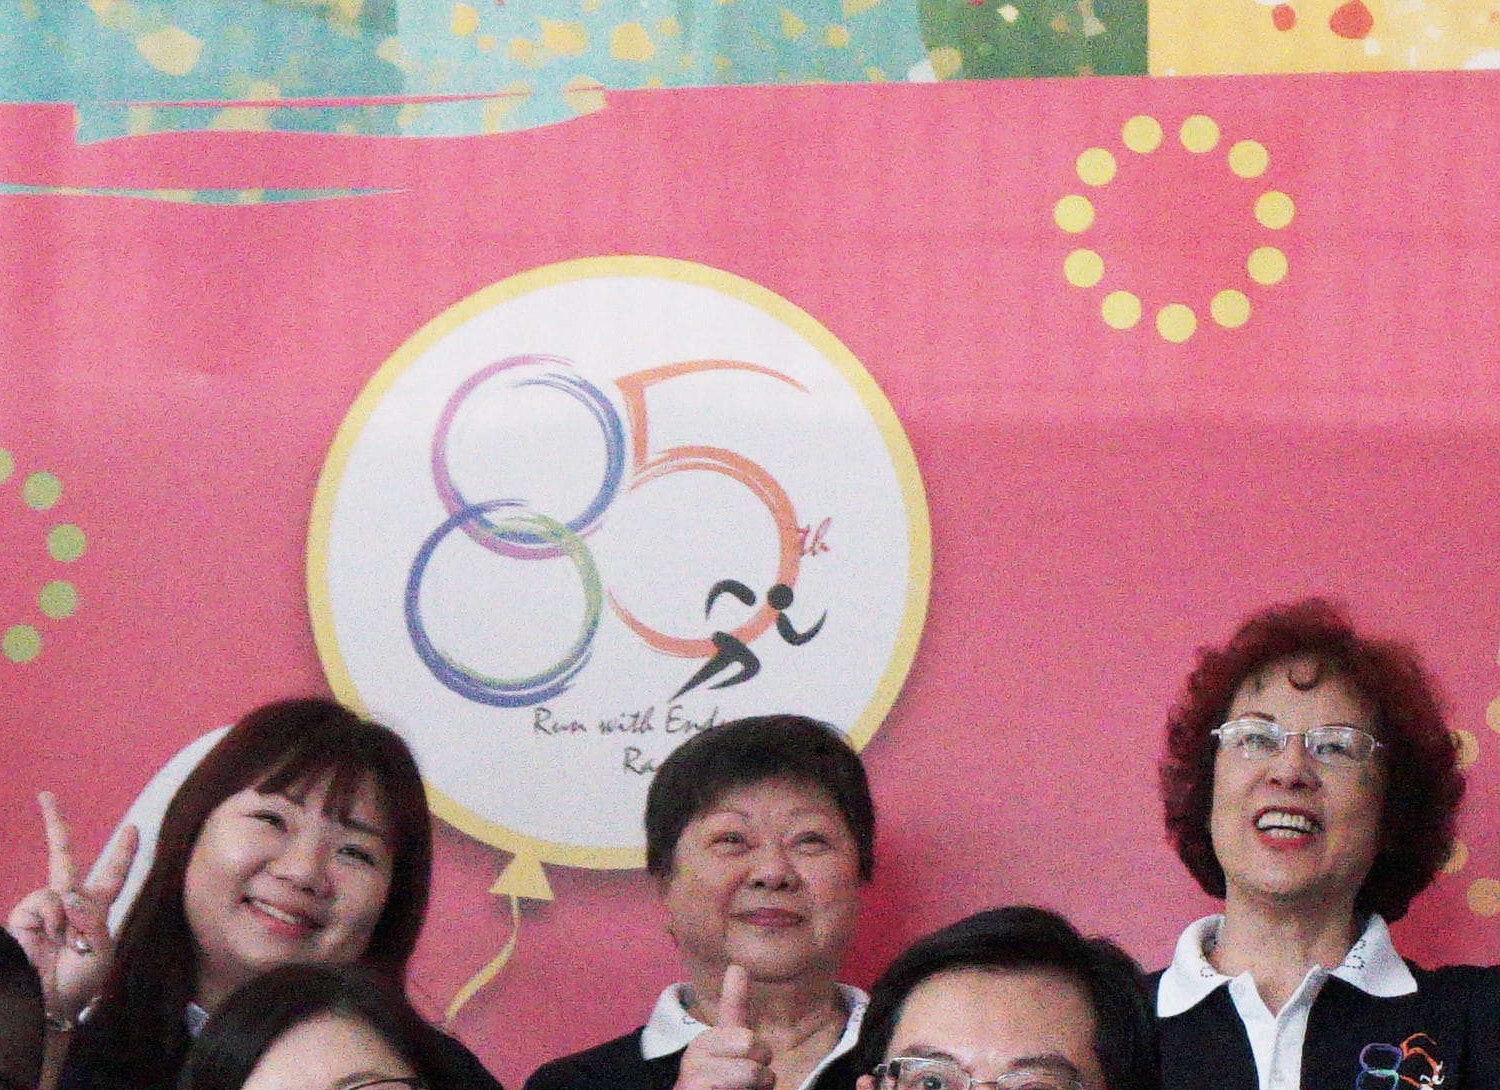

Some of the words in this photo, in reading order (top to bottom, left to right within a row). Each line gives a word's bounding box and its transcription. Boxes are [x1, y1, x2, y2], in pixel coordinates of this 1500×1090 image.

[533, 706, 587, 735] Run
[598, 706, 655, 735] with
[665, 704, 726, 734] End
[622, 747, 655, 775] Ra
